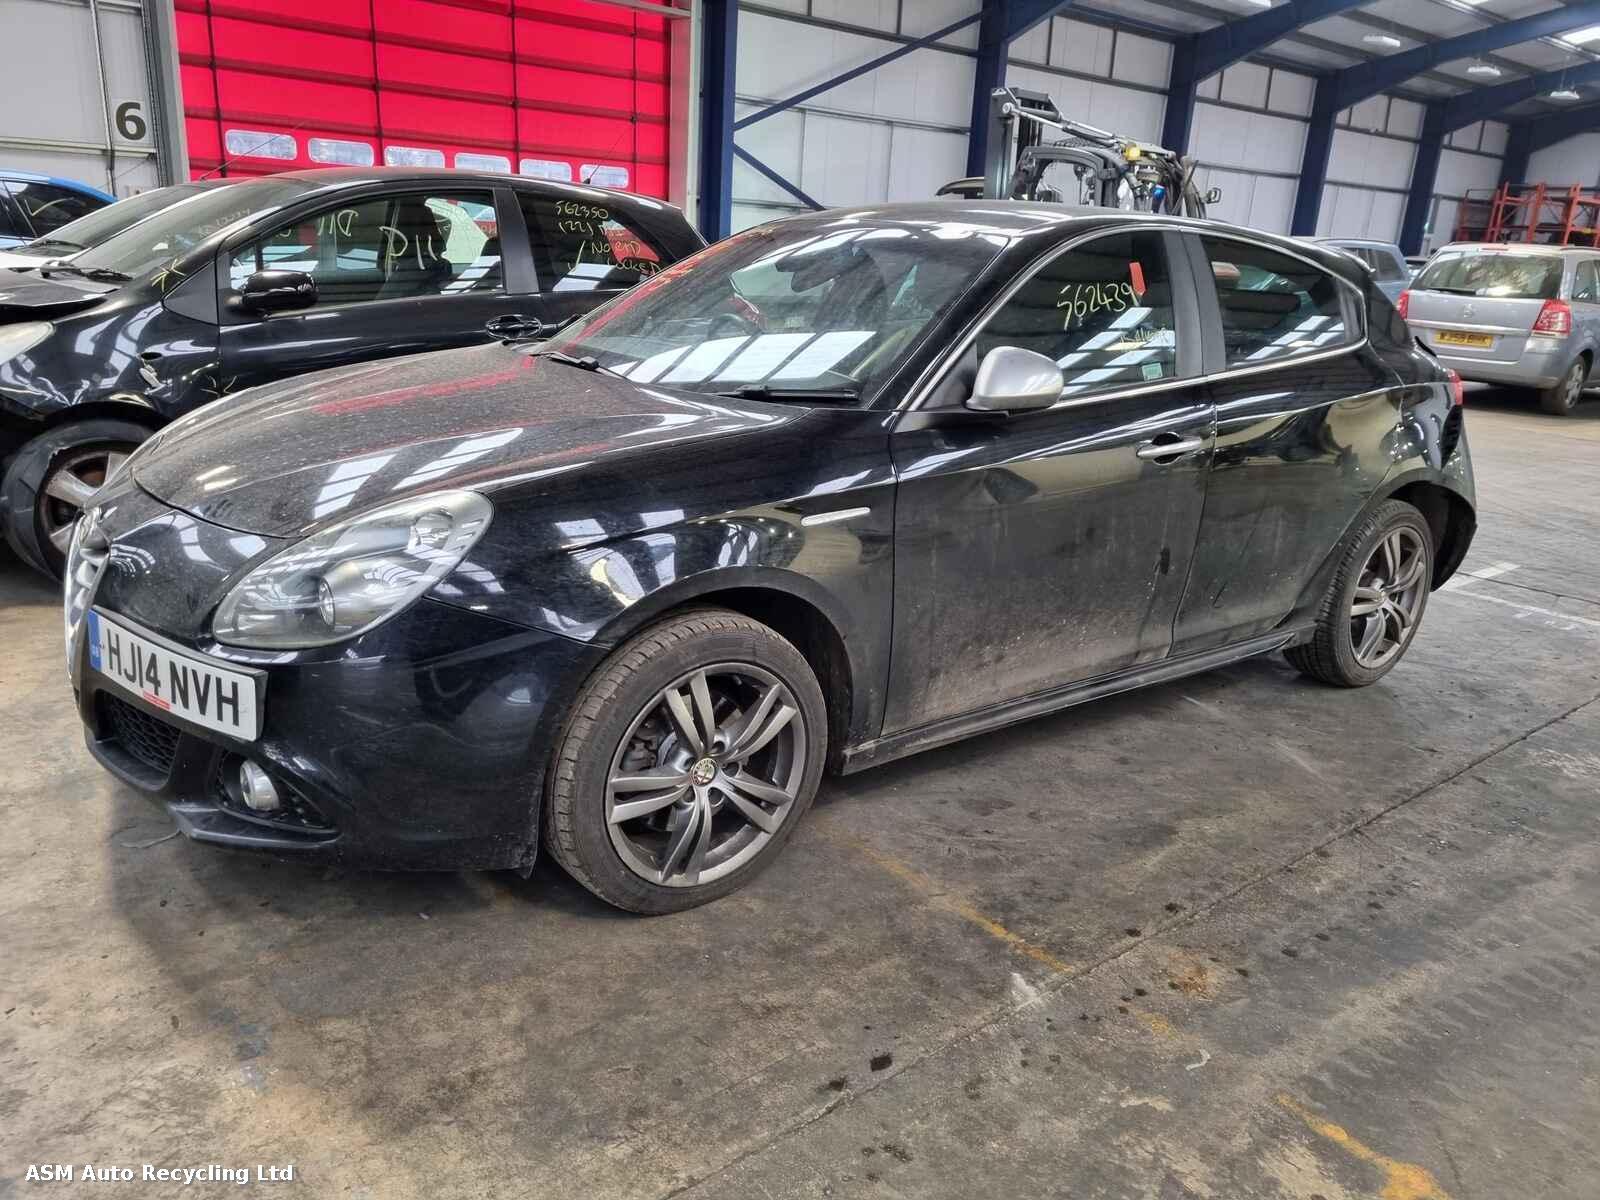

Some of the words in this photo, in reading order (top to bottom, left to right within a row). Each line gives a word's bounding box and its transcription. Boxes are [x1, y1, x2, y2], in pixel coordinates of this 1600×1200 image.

[115, 101, 146, 141] 6
[556, 200, 608, 219] 562350
[1057, 282, 1140, 331] 562439
[106, 627, 162, 697] HJ14
[169, 659, 240, 727] NVH
